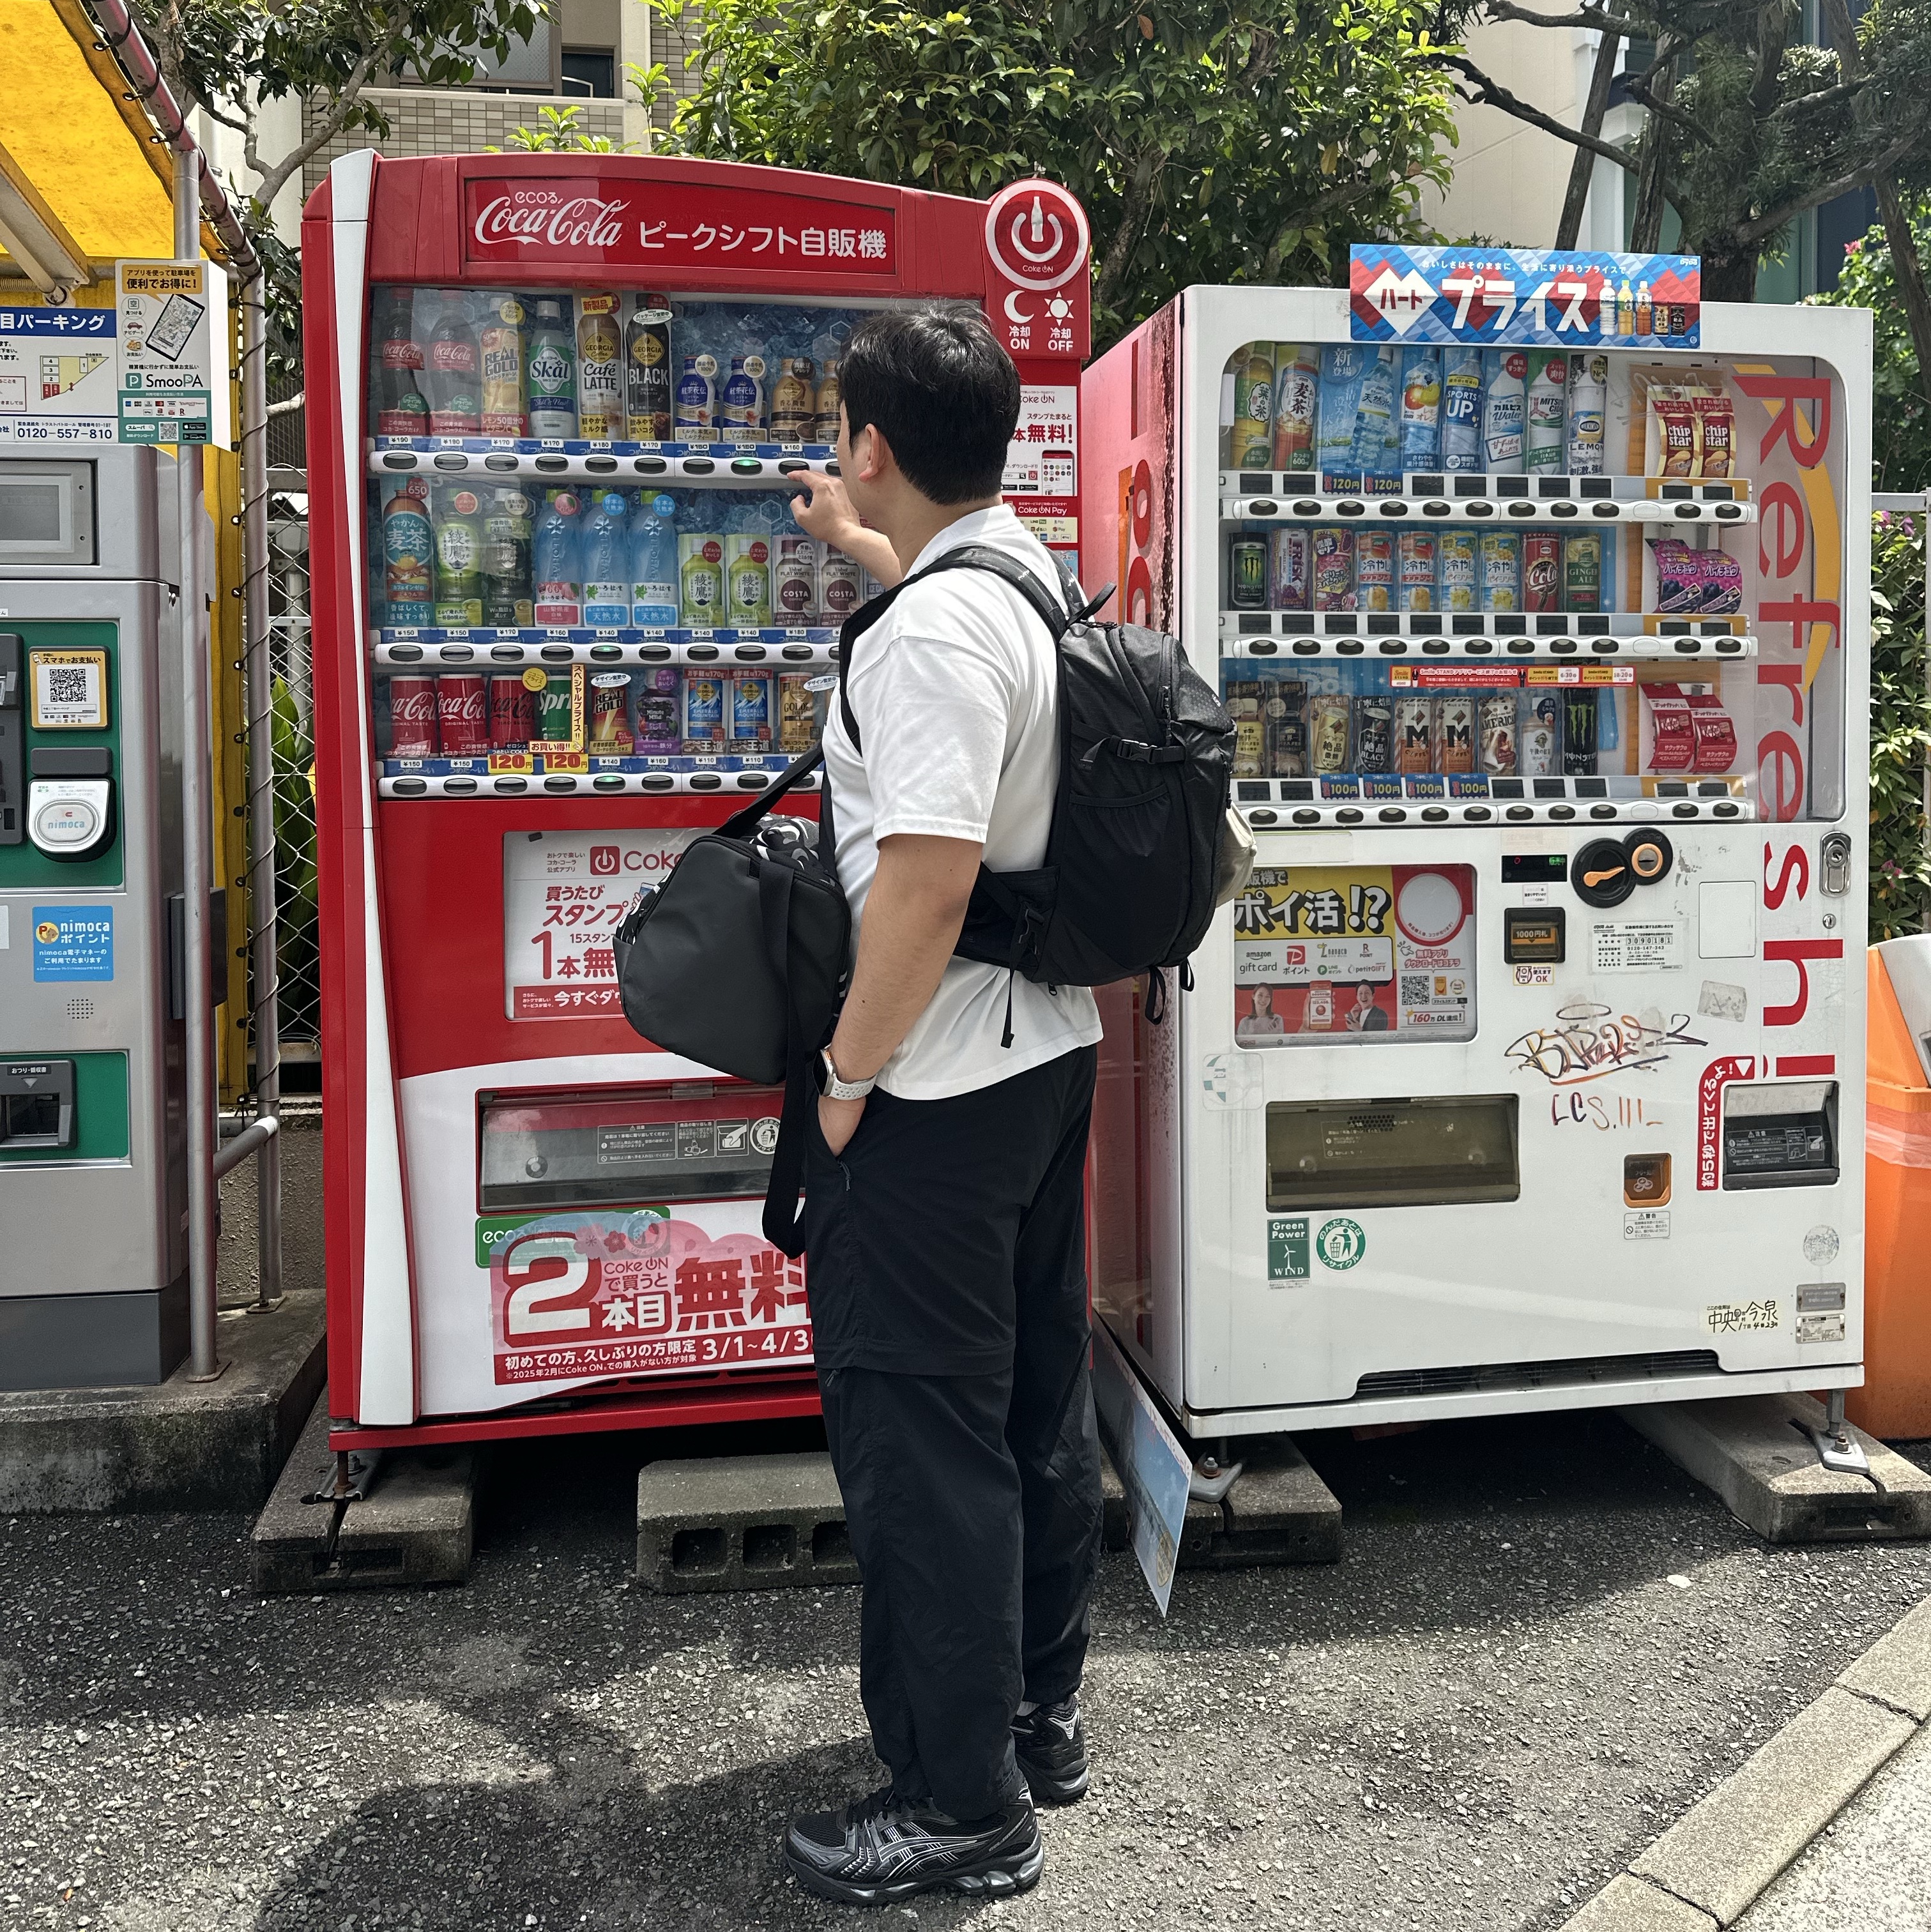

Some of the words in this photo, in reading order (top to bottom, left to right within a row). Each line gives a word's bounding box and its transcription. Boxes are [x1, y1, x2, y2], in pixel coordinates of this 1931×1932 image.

[475, 197, 631, 248] Coca-Cola
[639, 220, 887, 259] ピークシフト自販機
[1022, 264, 1041, 273] Coke
[127, 278, 197, 289] 便利でお得に!
[1380, 288, 1423, 310] ハート
[1441, 275, 1587, 331] プライス
[583, 300, 609, 311] 新製品
[1, 314, 105, 331] 目パーキング
[1009, 326, 1030, 338] 冷却
[1049, 328, 1072, 340] 冷却
[1010, 338, 1030, 351] ON
[1048, 340, 1074, 353] OFF
[485, 346, 519, 365] REAL
[1332, 347, 1353, 367] 新
[485, 360, 518, 378] GOLD
[584, 363, 616, 376] Café
[1332, 367, 1352, 377] 登場
[629, 368, 669, 386] BLACK
[584, 377, 617, 391] LATTE
[729, 387, 755, 395] 紅茶花伝
[1447, 390, 1477, 401] SPORTS
[1253, 386, 1268, 418] 葉の茶
[1292, 382, 1309, 415] 麦茶
[1361, 393, 1391, 407] 天然水
[1446, 399, 1474, 419] UP
[1668, 425, 1691, 437] chip
[1705, 425, 1728, 437] chip
[1668, 436, 1691, 446] star
[1705, 436, 1729, 446] star
[408, 486, 427, 494] 650
[1332, 478, 1360, 490] 120円
[1375, 479, 1401, 491] 120円
[386, 528, 429, 551] 麦茶
[448, 529, 466, 561] 綾鷹
[1362, 559, 1391, 572] 冷やし
[1405, 560, 1433, 572] 冷やし
[1446, 559, 1473, 572] 冷やし
[1488, 561, 1516, 573] 冷やし
[1663, 563, 1698, 575] ハイチュウ
[1704, 565, 1739, 577] ハイチュウ
[1528, 566, 1557, 587] Cola
[694, 574, 707, 599] 綾鷹
[742, 574, 755, 599] 綾鷹
[592, 612, 621, 621] 天然水
[641, 612, 669, 621] 天然水
[595, 688, 623, 704] REAL
[595, 699, 623, 714] GOLD
[531, 742, 570, 752] お買い得!!
[1322, 741, 1342, 752] 絶品
[1364, 742, 1384, 752] 絶品
[489, 755, 532, 769] 120円
[545, 754, 588, 769] 120円
[1361, 750, 1385, 762] BLACK
[1331, 784, 1358, 795] 100円
[1373, 784, 1400, 795] 100円
[1416, 784, 1443, 794] 100円
[1460, 783, 1488, 793] 100円
[48, 819, 85, 829] nimoca
[546, 884, 606, 902] 買うたび
[542, 900, 629, 927] スタンプ
[1235, 885, 1390, 932] ポイ活!?
[60, 920, 110, 932] nimoca
[60, 934, 110, 943] ポイント
[1516, 930, 1548, 938] 1000円札
[1415, 949, 1449, 959] 無料アプリ
[1239, 963, 1256, 974] gift
[1257, 962, 1278, 971] card
[1355, 965, 1386, 973] petitGIFT
[1405, 959, 1461, 968] ダウンロードはコチラ
[1283, 966, 1310, 975] ポイント
[1701, 1063, 1734, 1188] 約5秒で出てくるよ!
[1272, 1230, 1306, 1239] Power
[1319, 1219, 1363, 1240] のんだあとは
[605, 1261, 643, 1275] Coke
[1322, 1254, 1360, 1270] リサイクル
[1274, 1266, 1305, 1277] WIND
[507, 1236, 591, 1337] 2
[604, 1275, 669, 1293] で買うと
[601, 1293, 666, 1332] 本目
[1745, 1300, 1778, 1321] 今泉
[1708, 1309, 1737, 1333] 中央
